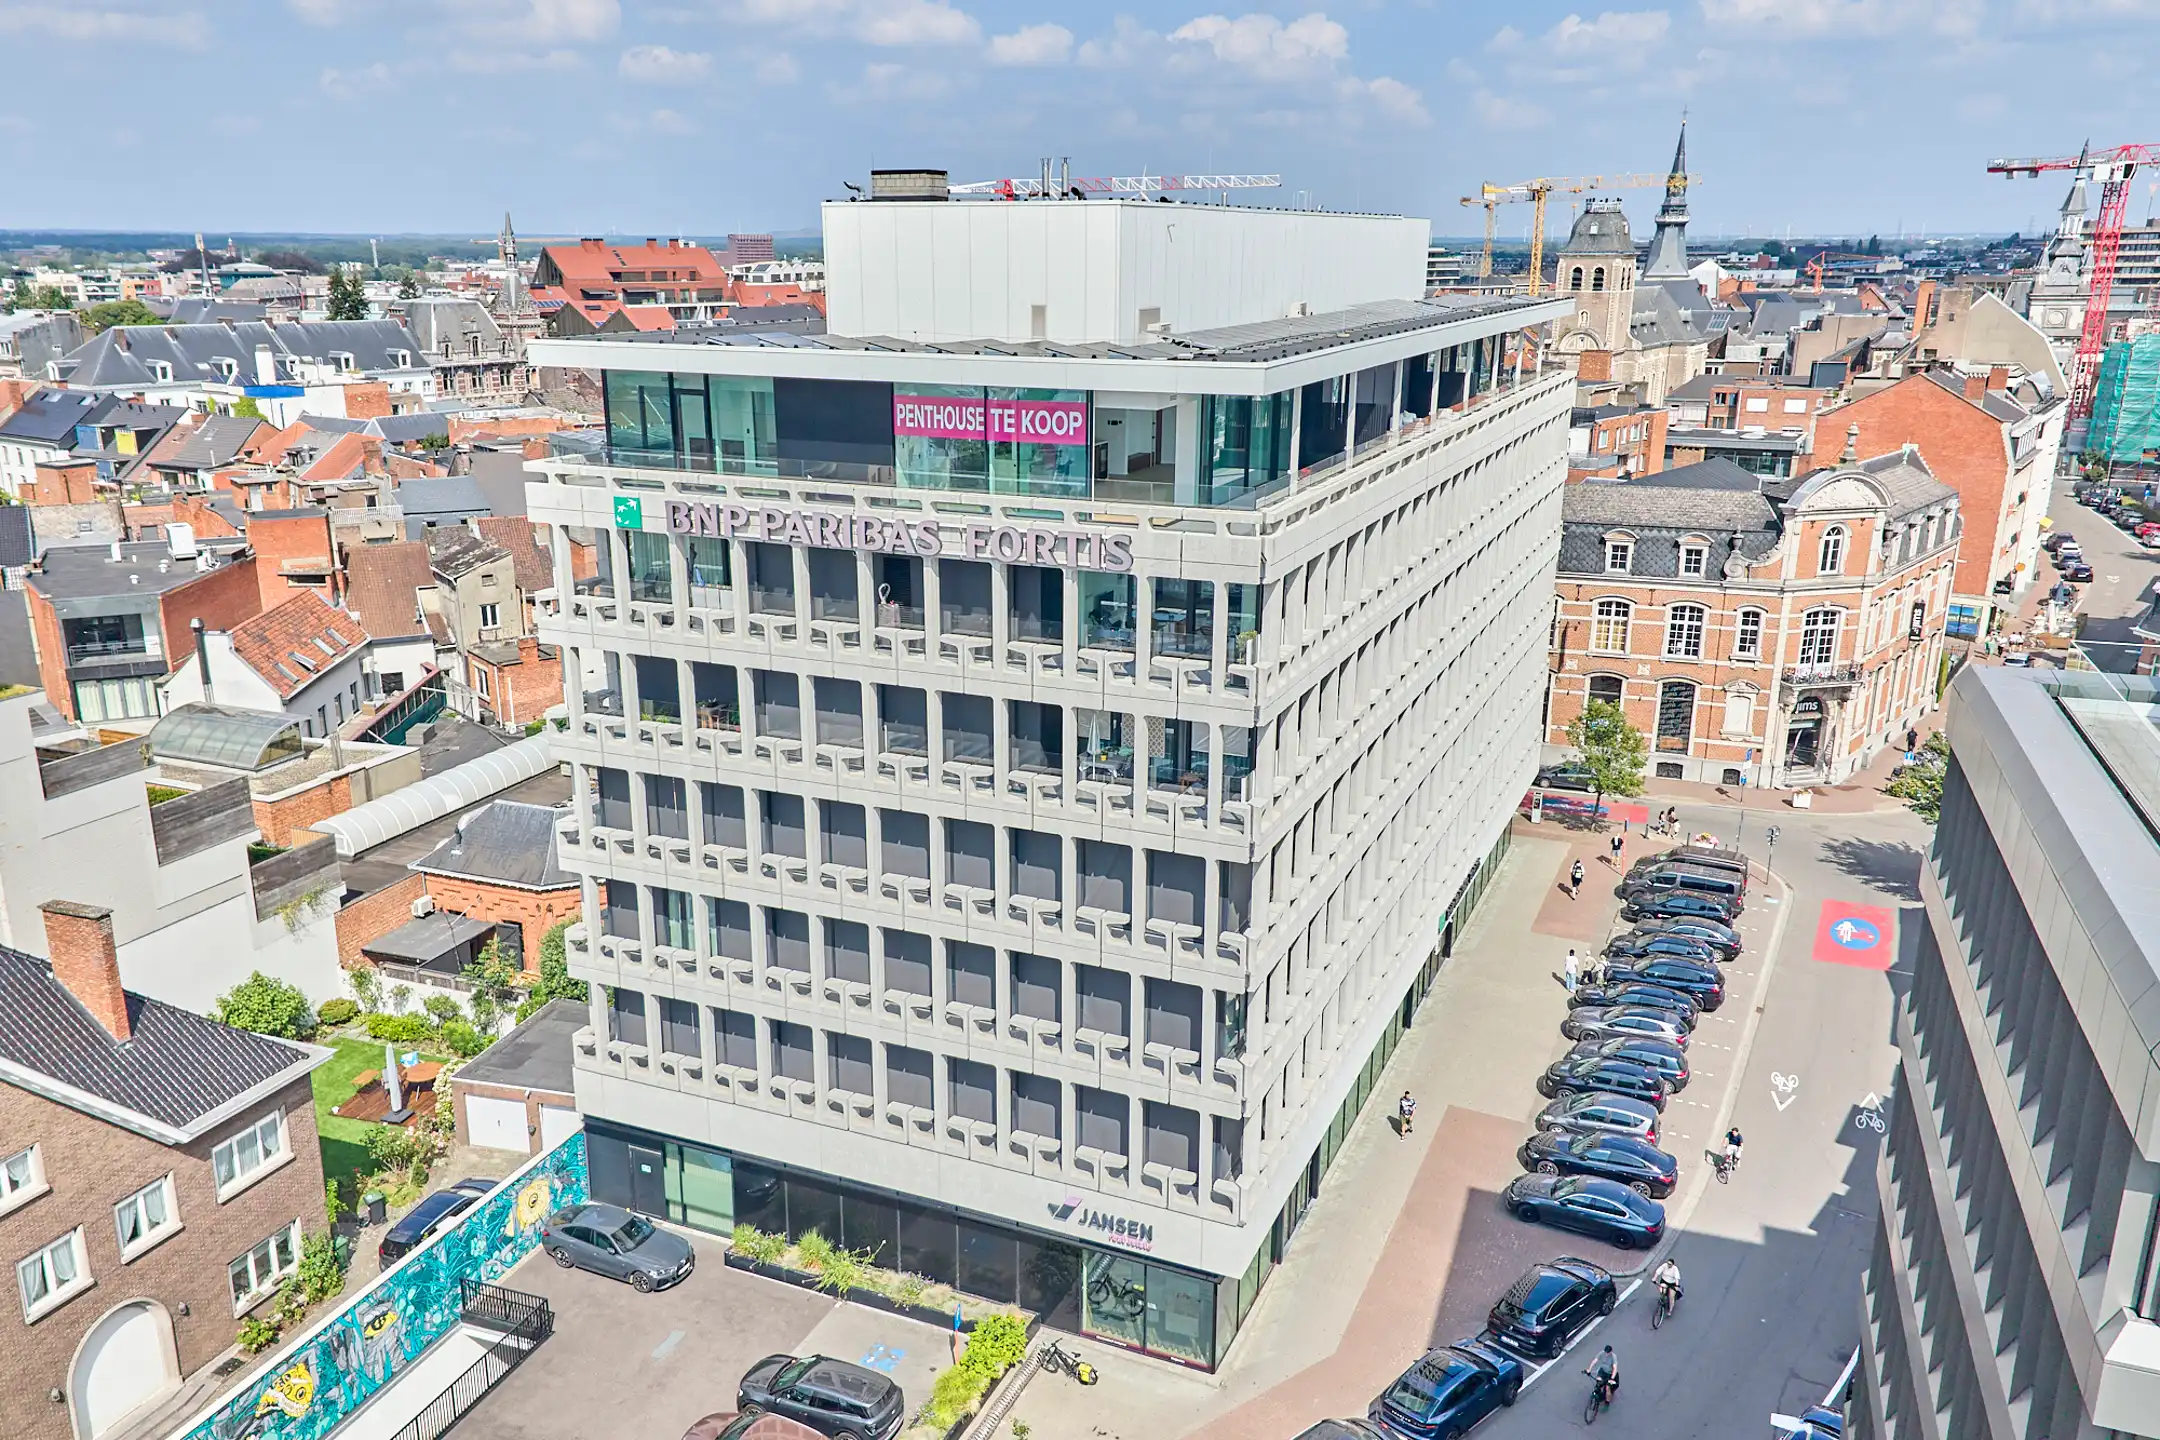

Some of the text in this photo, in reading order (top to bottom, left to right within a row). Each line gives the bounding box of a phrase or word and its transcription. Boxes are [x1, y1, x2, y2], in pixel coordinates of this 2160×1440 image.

[896, 403, 1083, 436] PENTHOUSE TE KOOP
[664, 500, 1134, 572] BNP PARIBAS FORTIS
[1077, 1208, 1154, 1243] JANSEN
